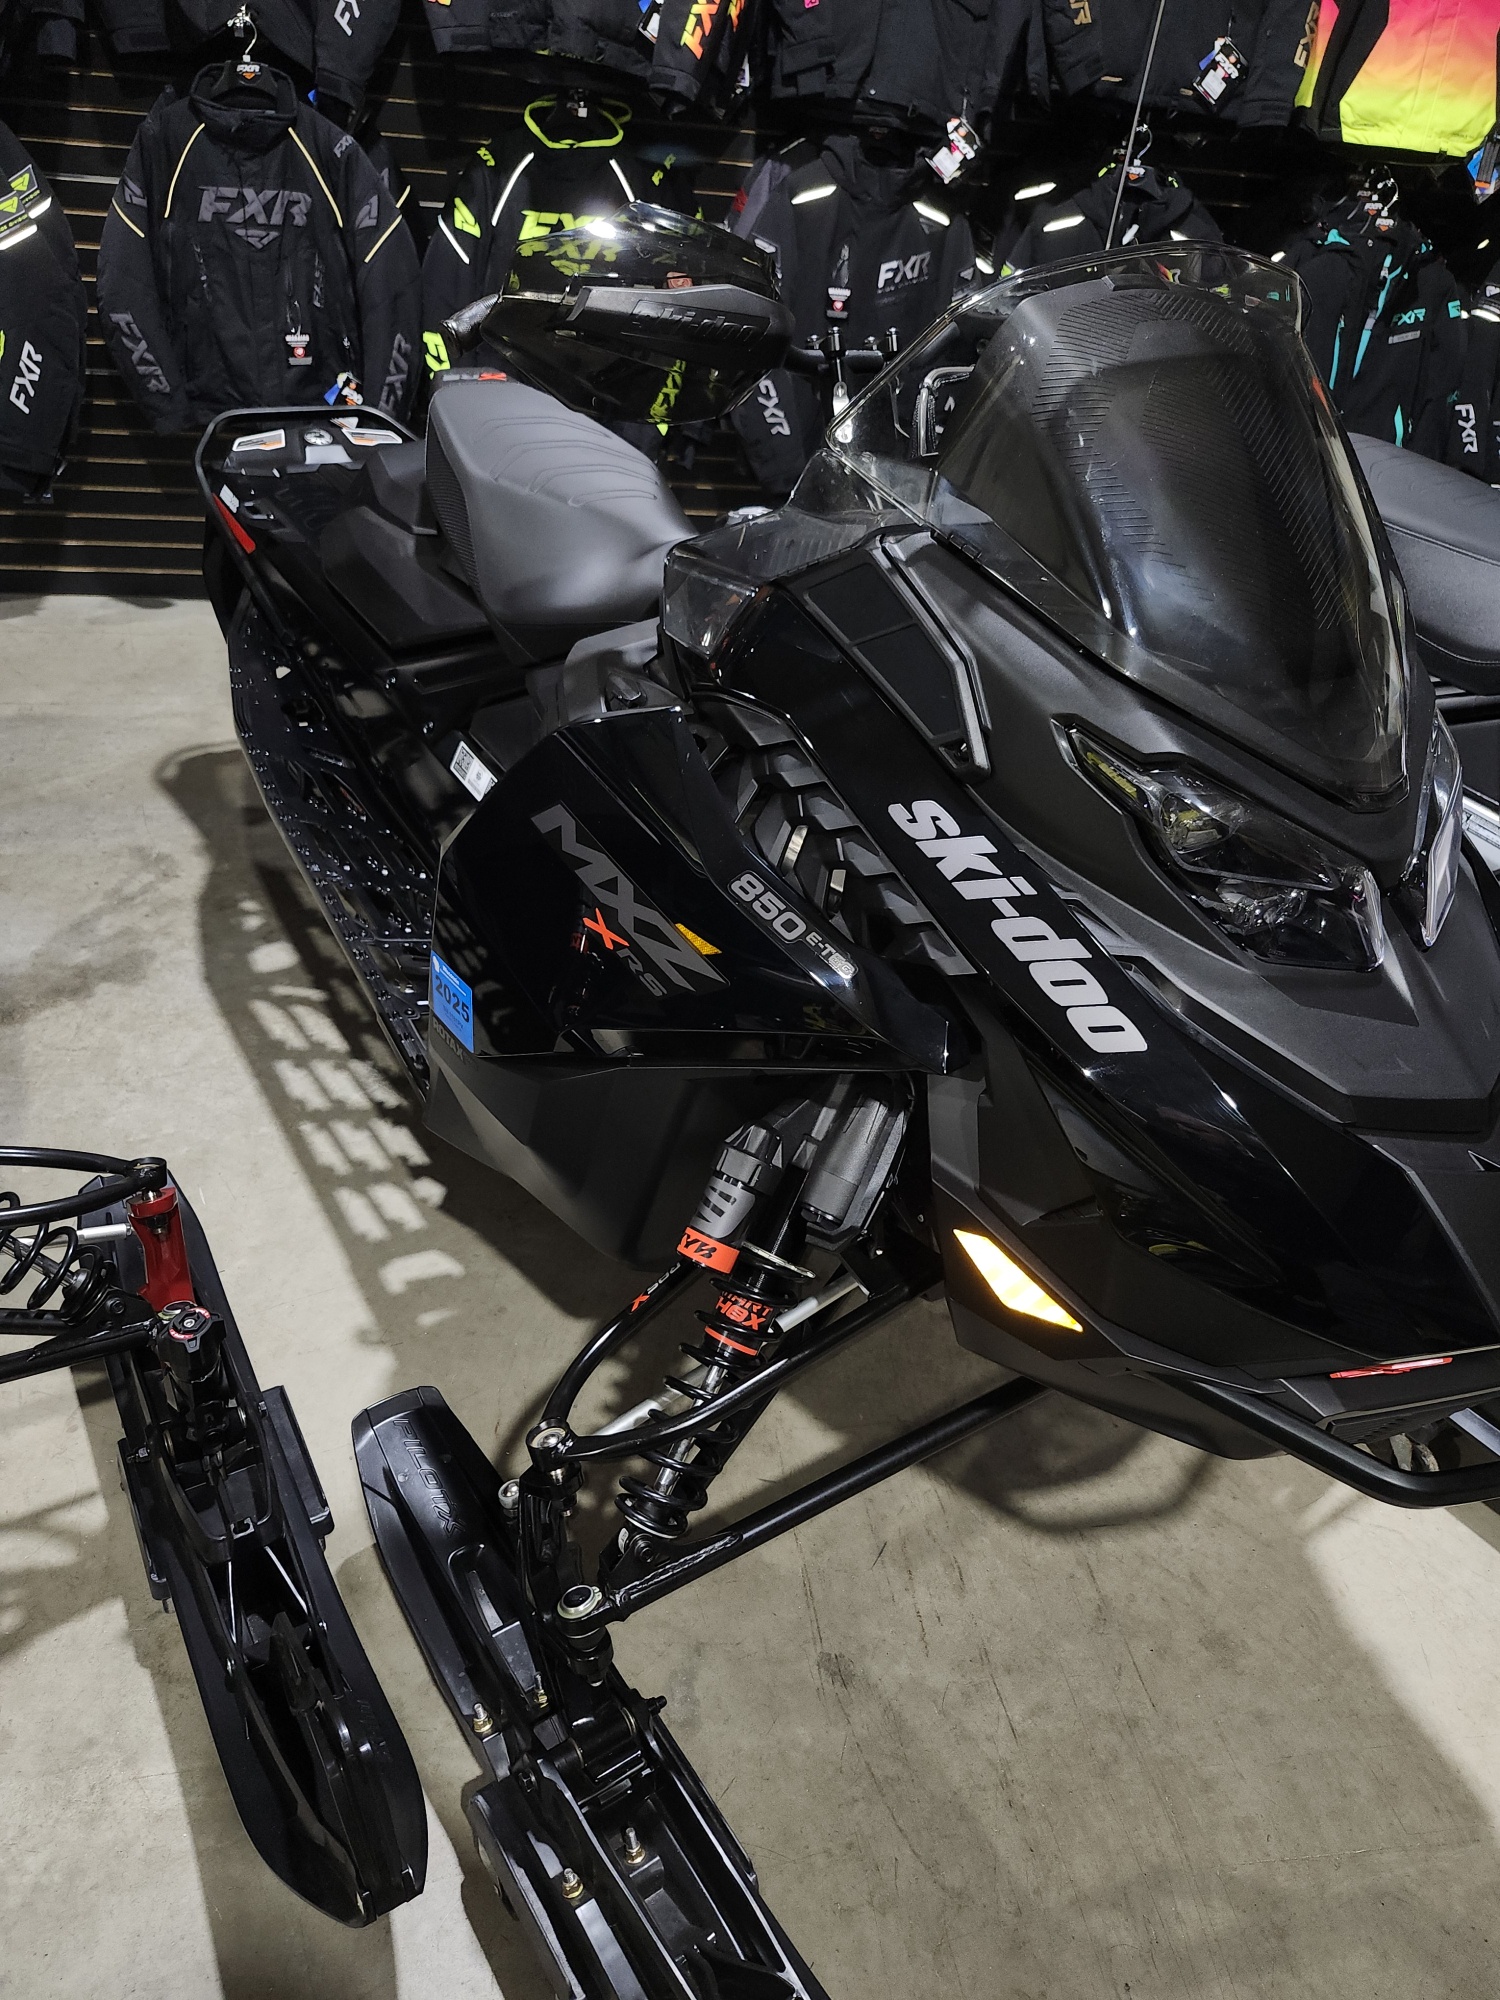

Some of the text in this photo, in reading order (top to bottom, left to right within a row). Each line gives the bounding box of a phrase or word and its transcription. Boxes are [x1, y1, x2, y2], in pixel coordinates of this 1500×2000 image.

[197, 186, 313, 228] FXR
[9, 340, 43, 415] FXR
[757, 379, 792, 436] FXR
[1454, 403, 1479, 454] FXR
[531, 803, 726, 992] MXZ
[730, 873, 807, 941] 850
[435, 973, 470, 1023] 2025
